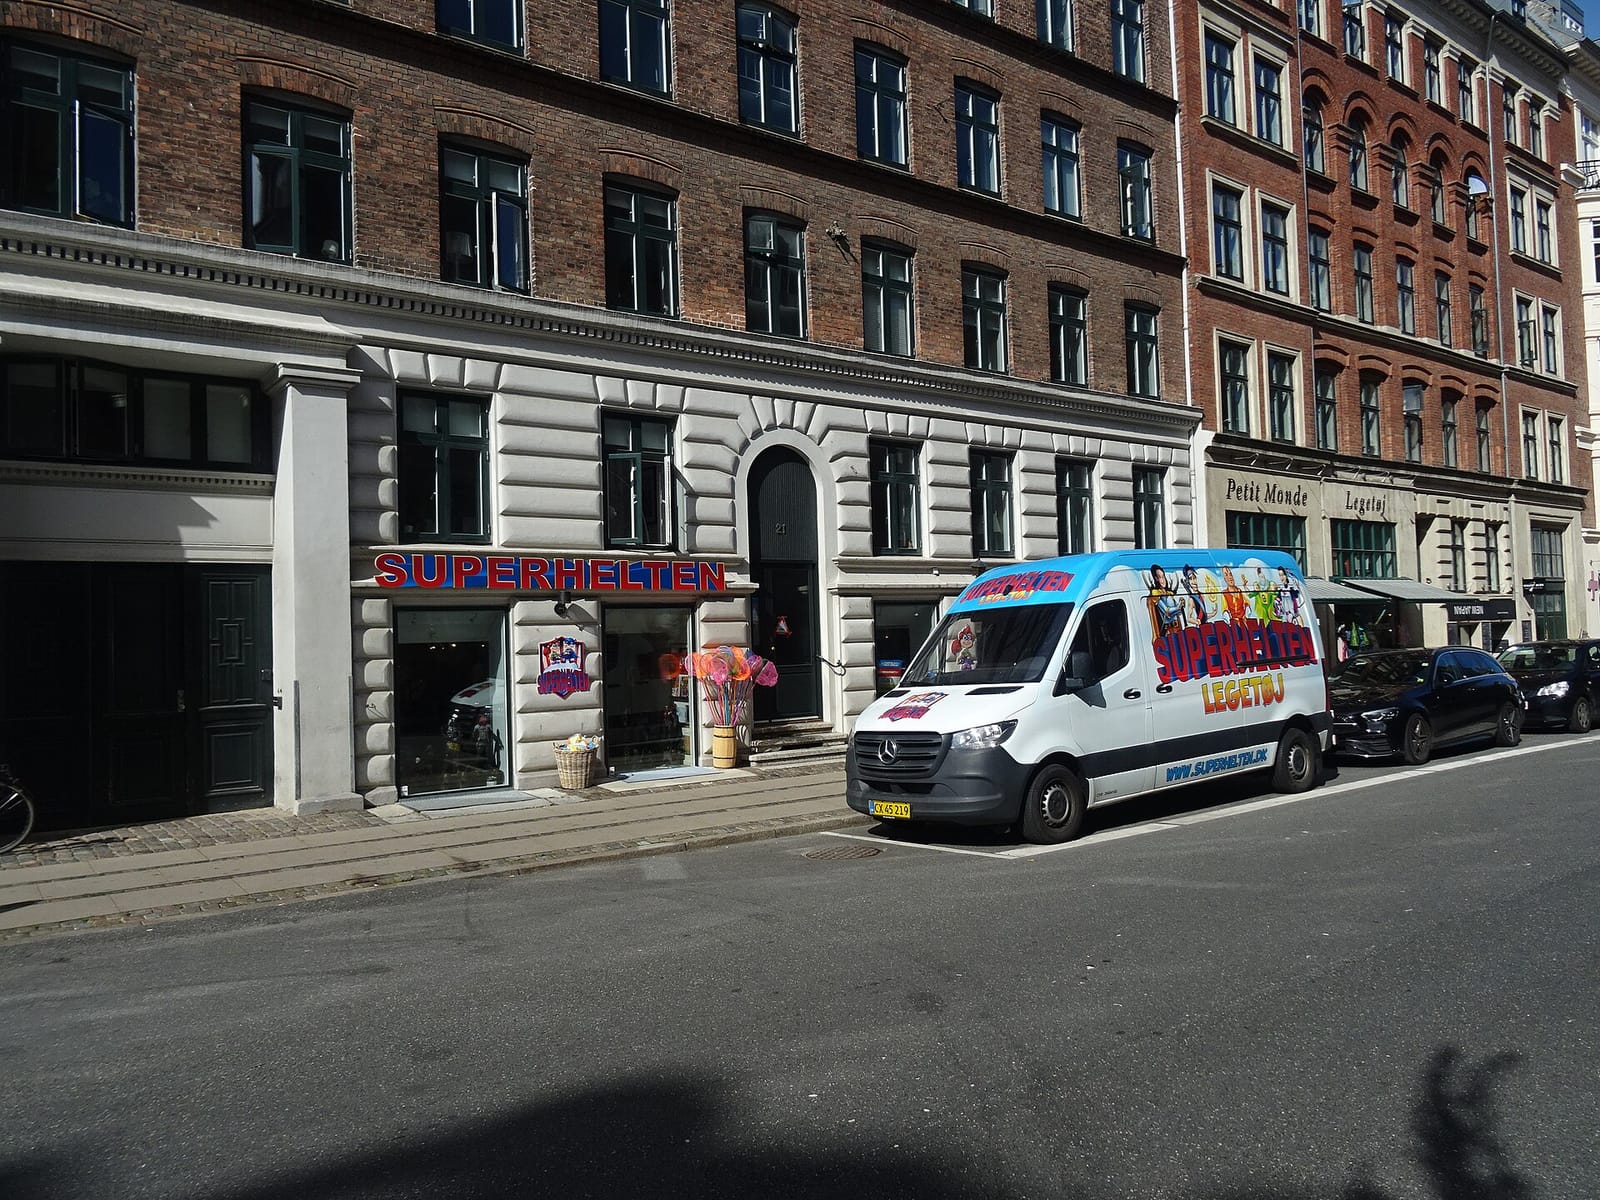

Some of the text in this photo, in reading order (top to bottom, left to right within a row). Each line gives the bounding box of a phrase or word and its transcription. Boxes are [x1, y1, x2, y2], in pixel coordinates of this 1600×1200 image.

[1226, 478, 1308, 507] Petit Monde
[1345, 490, 1387, 516] Legetøj
[374, 553, 727, 591] SUPERHELTEN
[978, 590, 1034, 604] LEGTØJ
[1153, 617, 1317, 684] SUPERHELTEN
[1201, 672, 1284, 714] LEGETØJ
[1166, 749, 1268, 782] WWW.SUPERHELTEN.DK
[894, 805, 909, 816] 219
